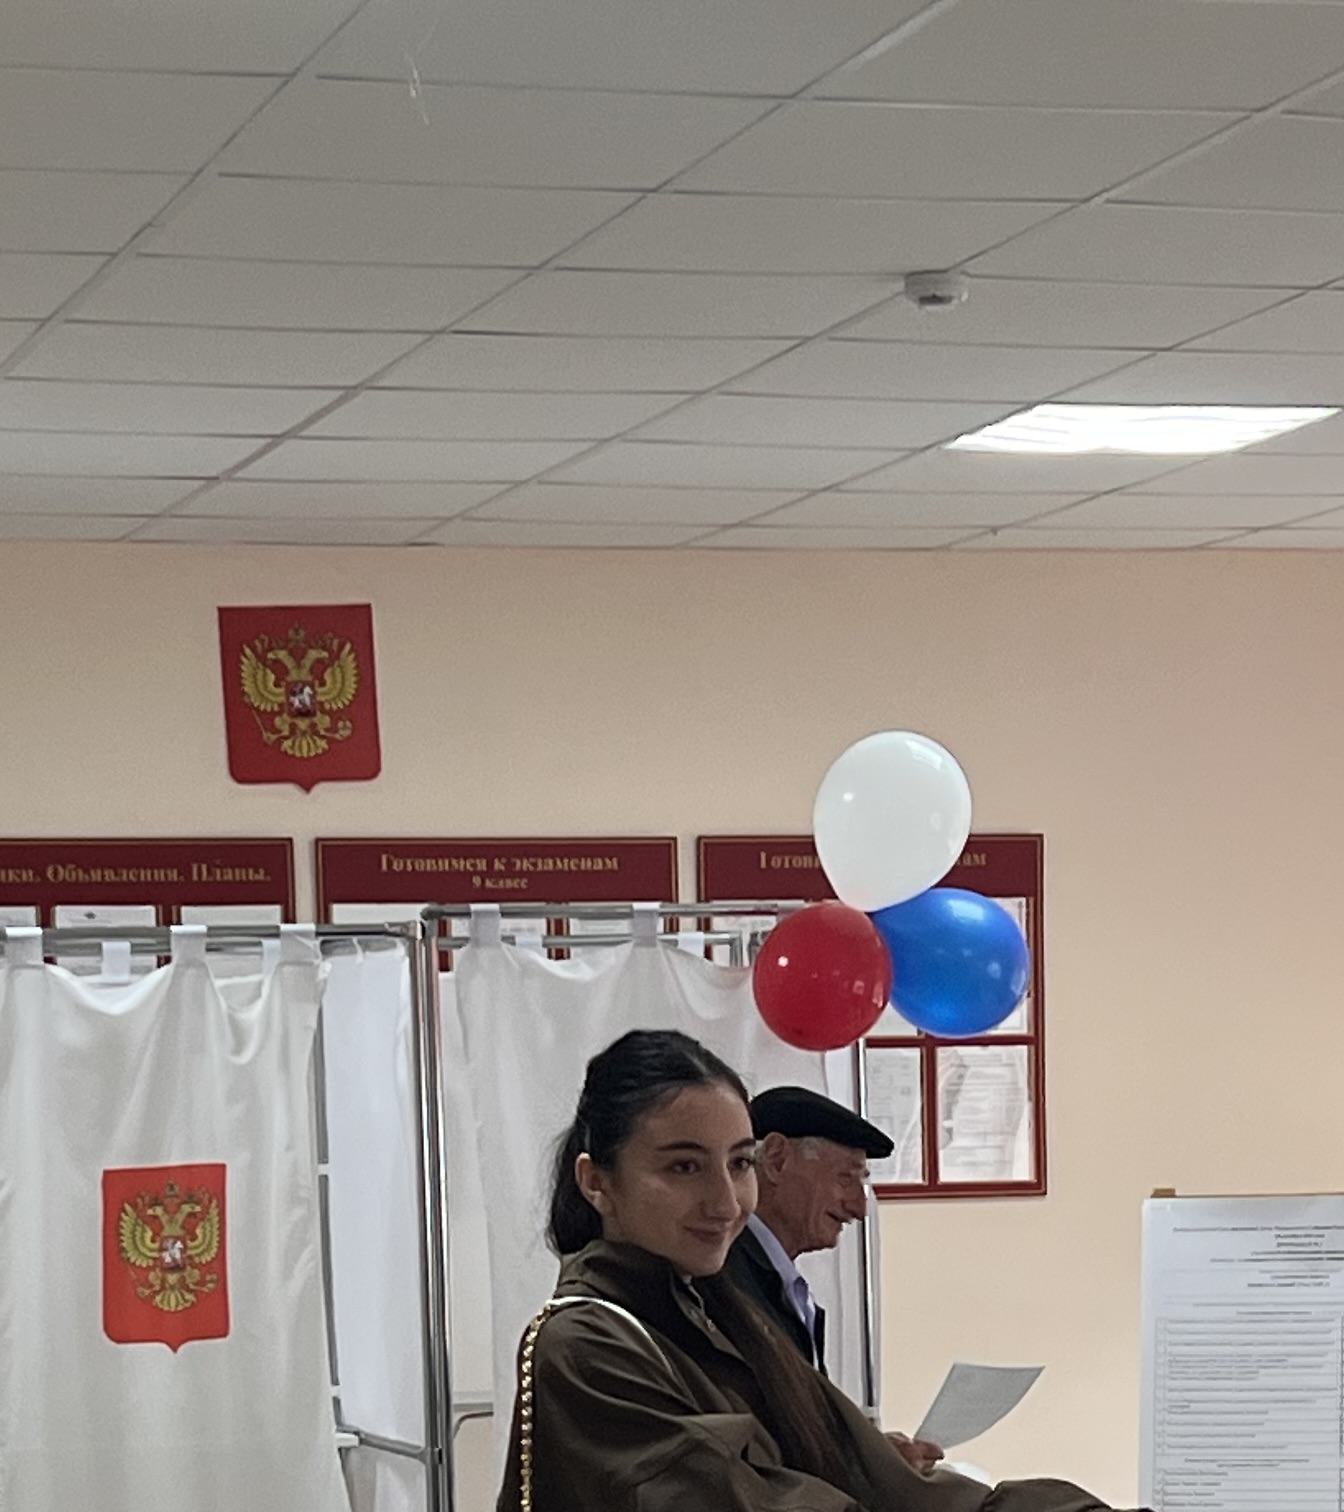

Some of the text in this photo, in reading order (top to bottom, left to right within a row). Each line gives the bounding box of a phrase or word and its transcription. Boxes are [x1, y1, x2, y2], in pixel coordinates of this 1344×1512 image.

[381, 853, 619, 873] Готовимся к экзаменам
[472, 875, 529, 890] 9 класс
